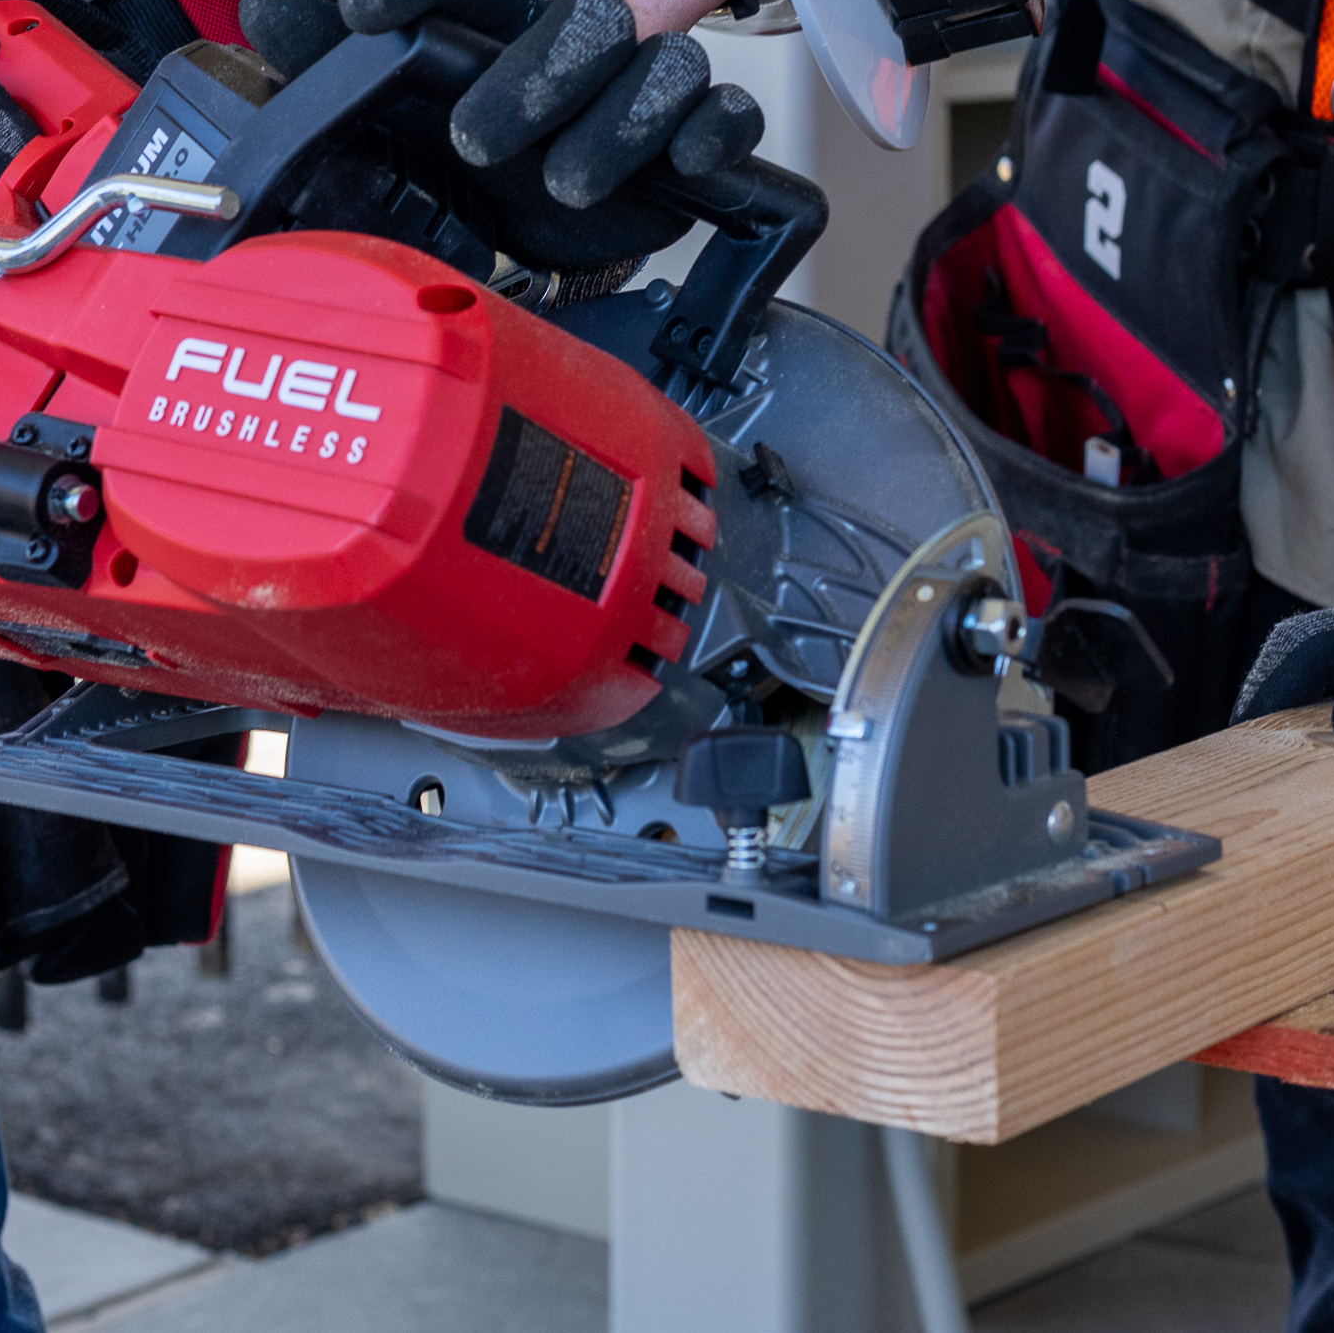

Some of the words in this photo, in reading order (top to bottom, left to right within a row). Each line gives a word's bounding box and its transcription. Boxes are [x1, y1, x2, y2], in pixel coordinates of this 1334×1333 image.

[1083, 158, 1127, 282] 2
[164, 336, 382, 423] FUEL
[147, 395, 368, 465] BRUSHLESS
